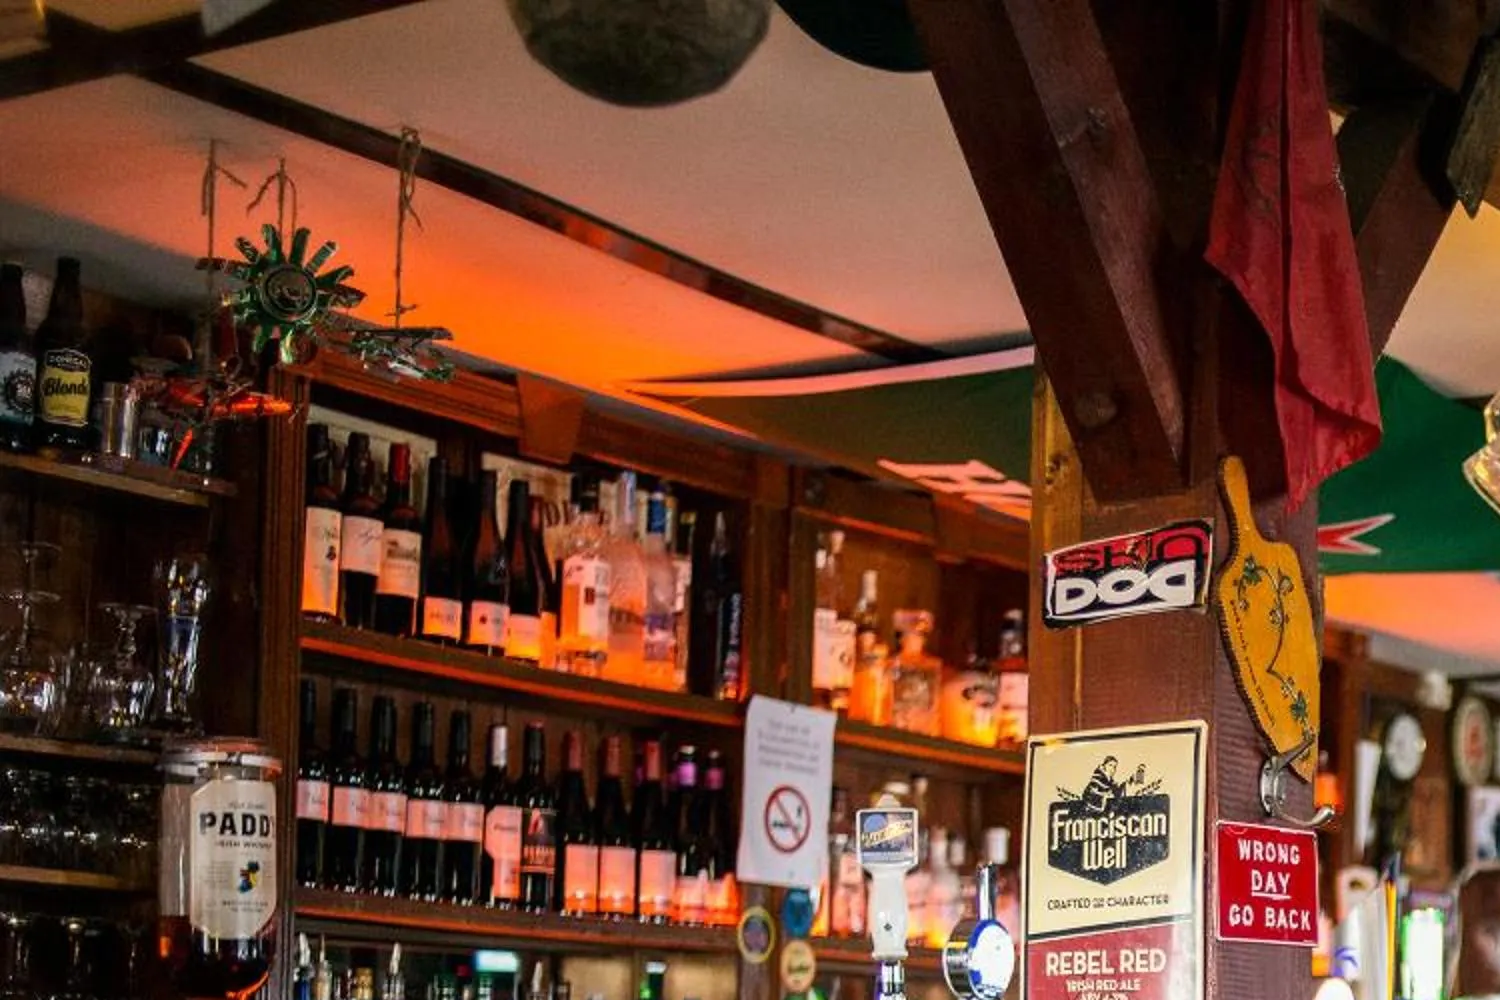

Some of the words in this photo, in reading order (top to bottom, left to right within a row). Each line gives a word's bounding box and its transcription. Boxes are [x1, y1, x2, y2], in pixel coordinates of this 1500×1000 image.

[1051, 808, 1167, 851] Franciscan
[1082, 837, 1127, 871] Well
[1237, 838, 1301, 865] WRONG
[1251, 868, 1291, 894] DAY
[1047, 897, 1091, 911] CRAFTED
[1107, 893, 1169, 906] CHARACTER
[1229, 903, 1254, 927] GO
[1265, 906, 1311, 931] BACK
[1045, 950, 1115, 977] REBEL
[1119, 947, 1167, 974] RED
[1066, 978, 1095, 992] IRISH
[1096, 979, 1118, 991] RED
[1120, 978, 1141, 991] ALE
